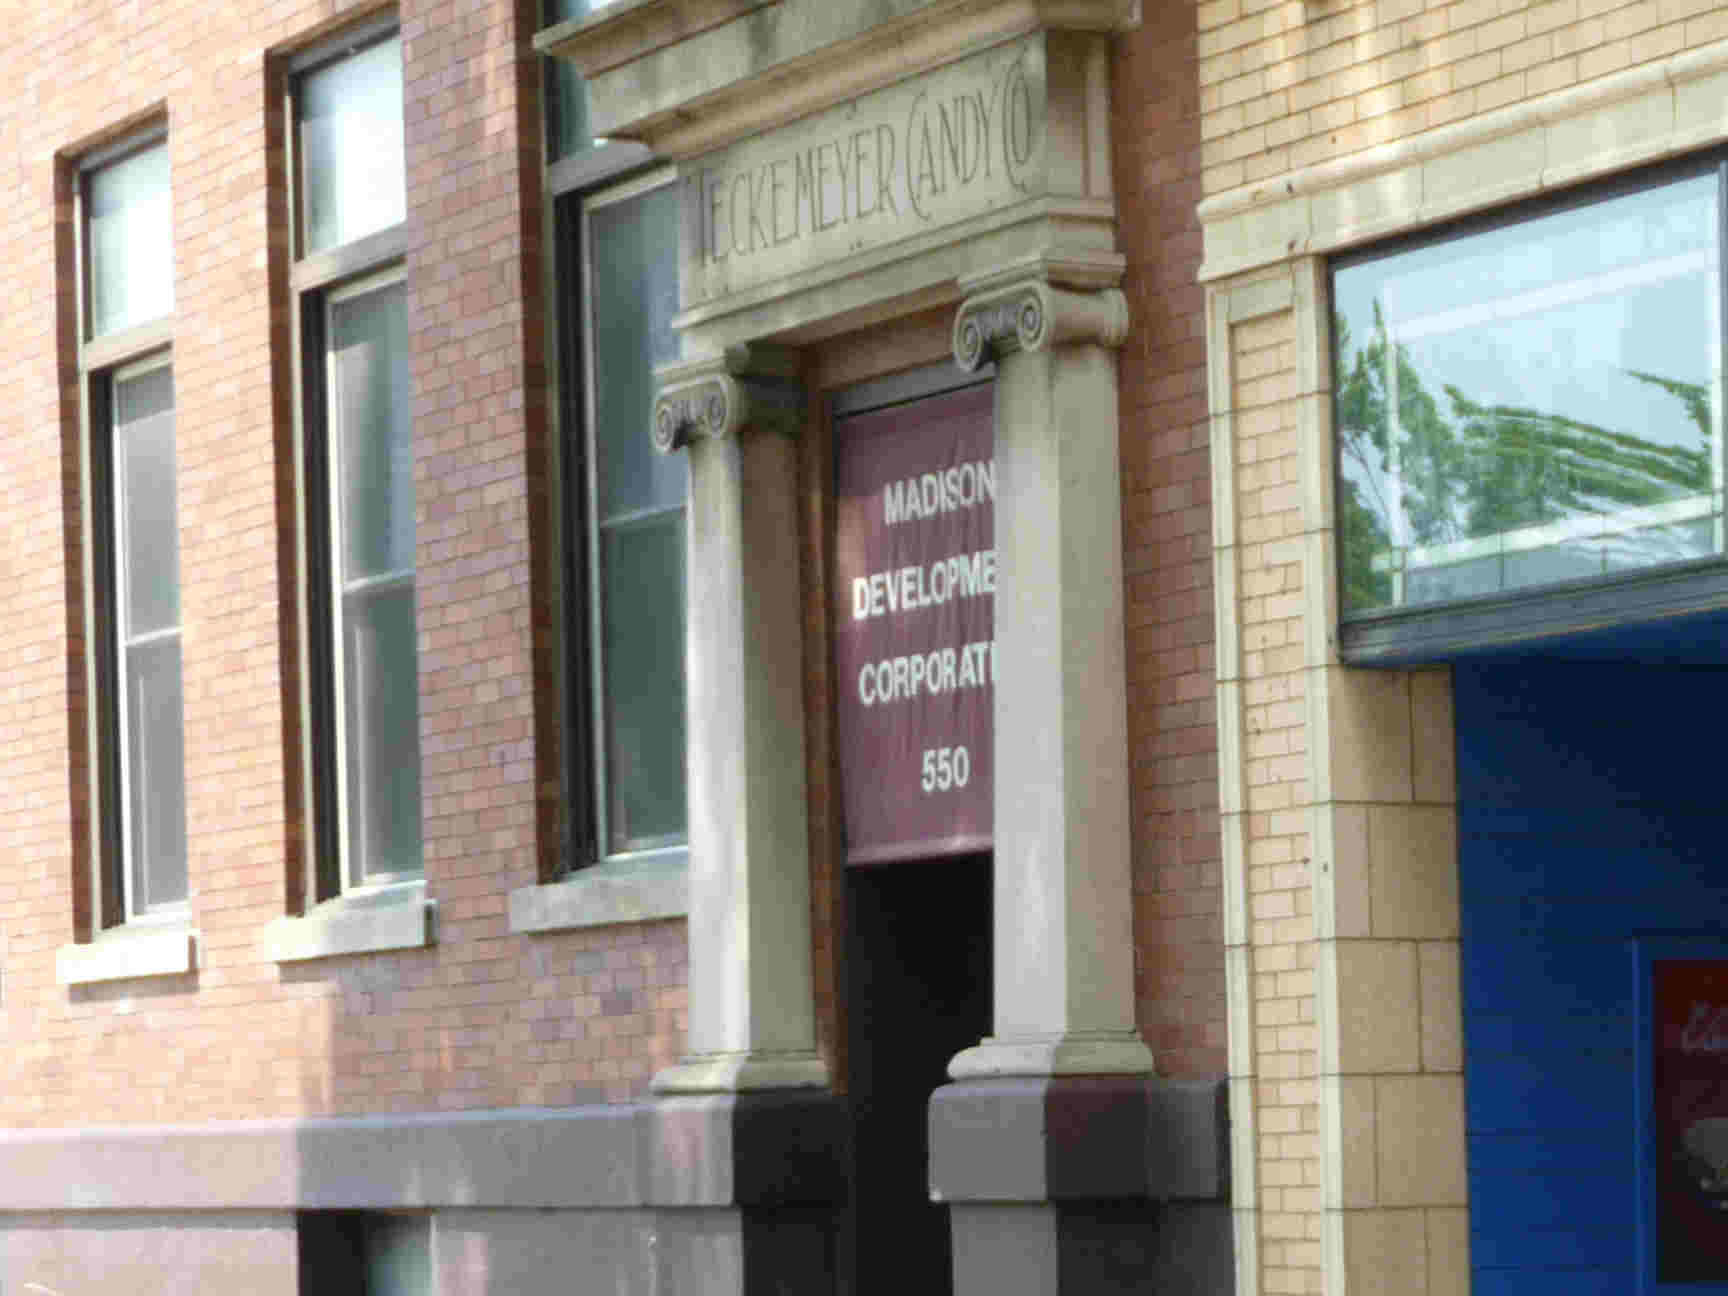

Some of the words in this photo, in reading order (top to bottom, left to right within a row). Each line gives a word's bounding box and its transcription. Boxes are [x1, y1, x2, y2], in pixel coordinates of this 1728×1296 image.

[906, 80, 1001, 221] CANDY
[884, 461, 998, 525] MADISON
[921, 746, 970, 792] 550
